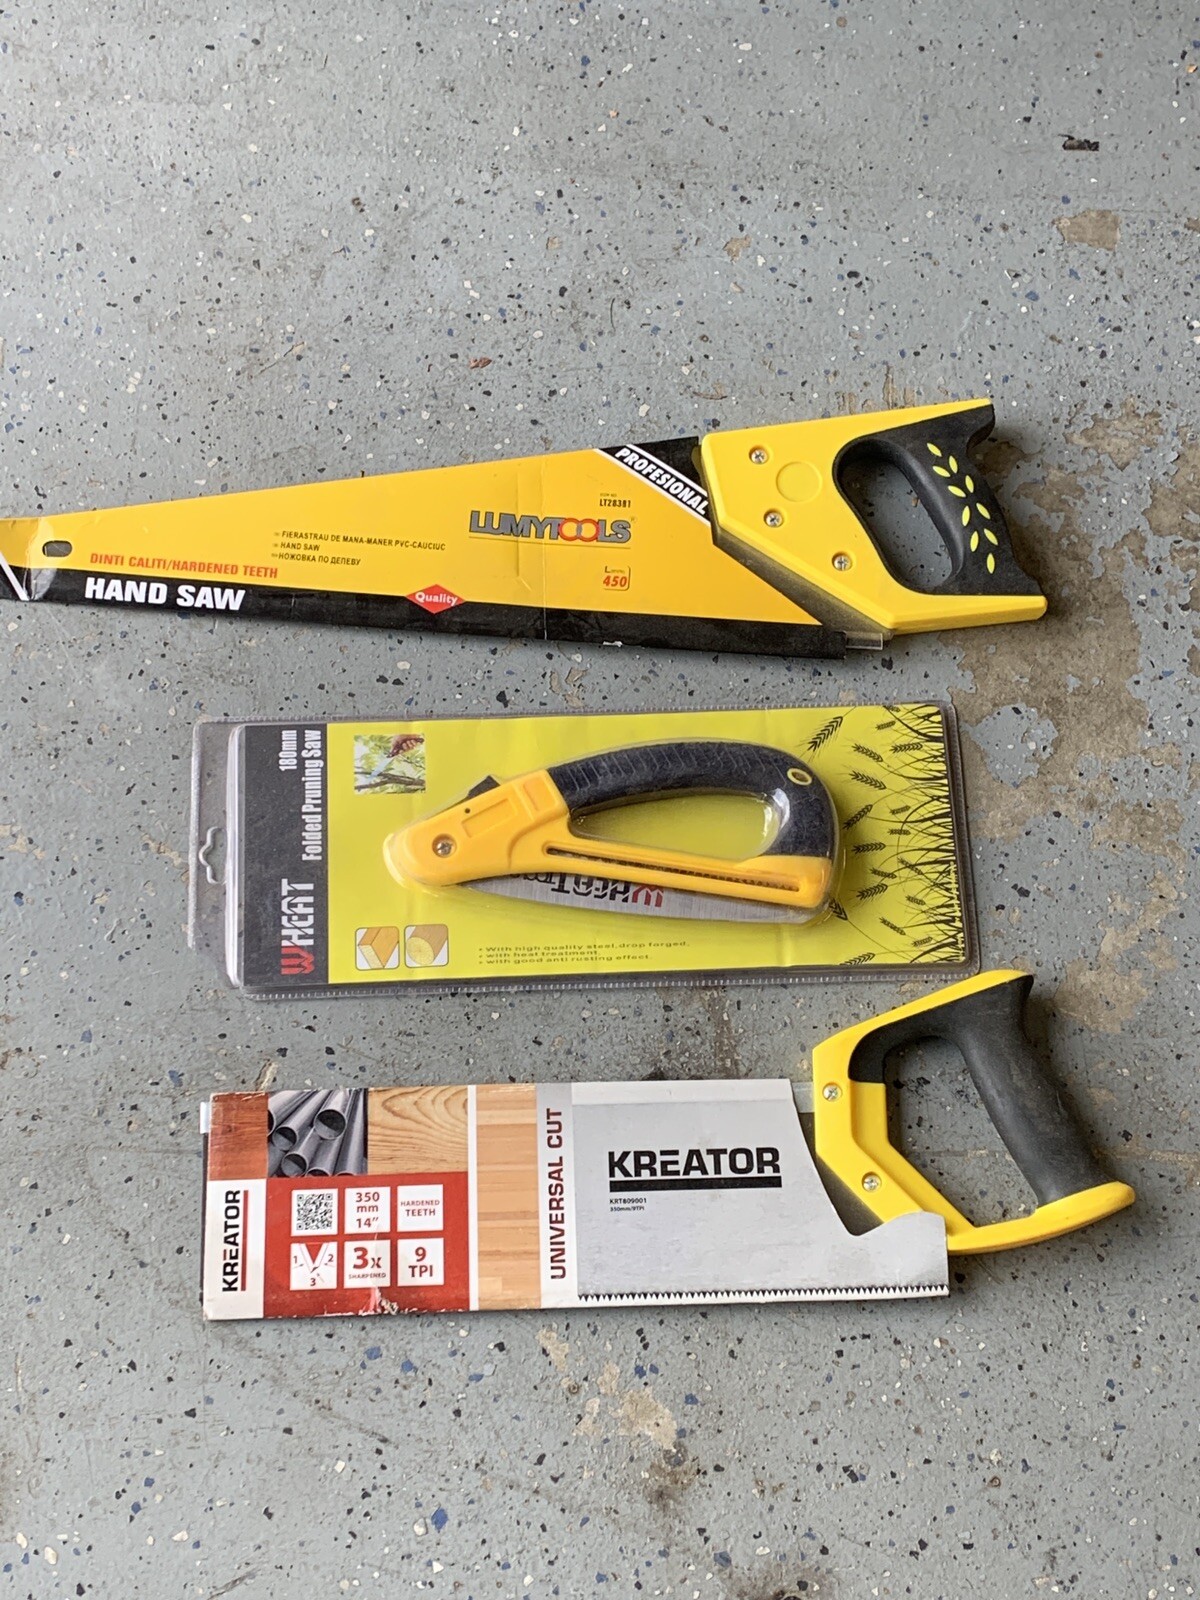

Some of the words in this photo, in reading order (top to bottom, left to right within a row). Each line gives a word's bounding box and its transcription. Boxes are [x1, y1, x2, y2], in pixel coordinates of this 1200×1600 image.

[615, 447, 709, 515] PROFESIONAL
[469, 510, 632, 544] LUMYTOOLS
[280, 542, 302, 551] HAND
[303, 543, 320, 552] SAW
[331, 534, 341, 543] DE
[342, 535, 393, 547] MANA-MANER
[90, 553, 124, 567] DINTI
[129, 556, 239, 576] CALITI/HARDENED
[243, 565, 278, 579] TEETH
[603, 575, 627, 588] 450
[84, 577, 168, 605] HAND
[176, 584, 246, 611] SAW
[415, 591, 458, 606] Quality
[279, 730, 298, 771] 180mm
[302, 730, 322, 758] Saw
[302, 759, 325, 813] Pruning
[302, 814, 323, 861] Folded
[546, 1108, 563, 1149] CUT
[608, 1147, 781, 1178] KREATOR
[355, 1191, 380, 1203] 350
[400, 1199, 440, 1207] HARDENED
[356, 1204, 379, 1213] mm
[405, 1208, 436, 1218] TEETH
[548, 1156, 567, 1280] UNIVERSAL
[222, 1190, 241, 1292] KREATOR
[293, 1255, 298, 1264] 1
[328, 1253, 334, 1263] 2
[415, 1246, 427, 1262] 9
[348, 1272, 387, 1280] SHARPENED
[408, 1264, 434, 1278] TPI
[310, 1277, 316, 1287] 3
